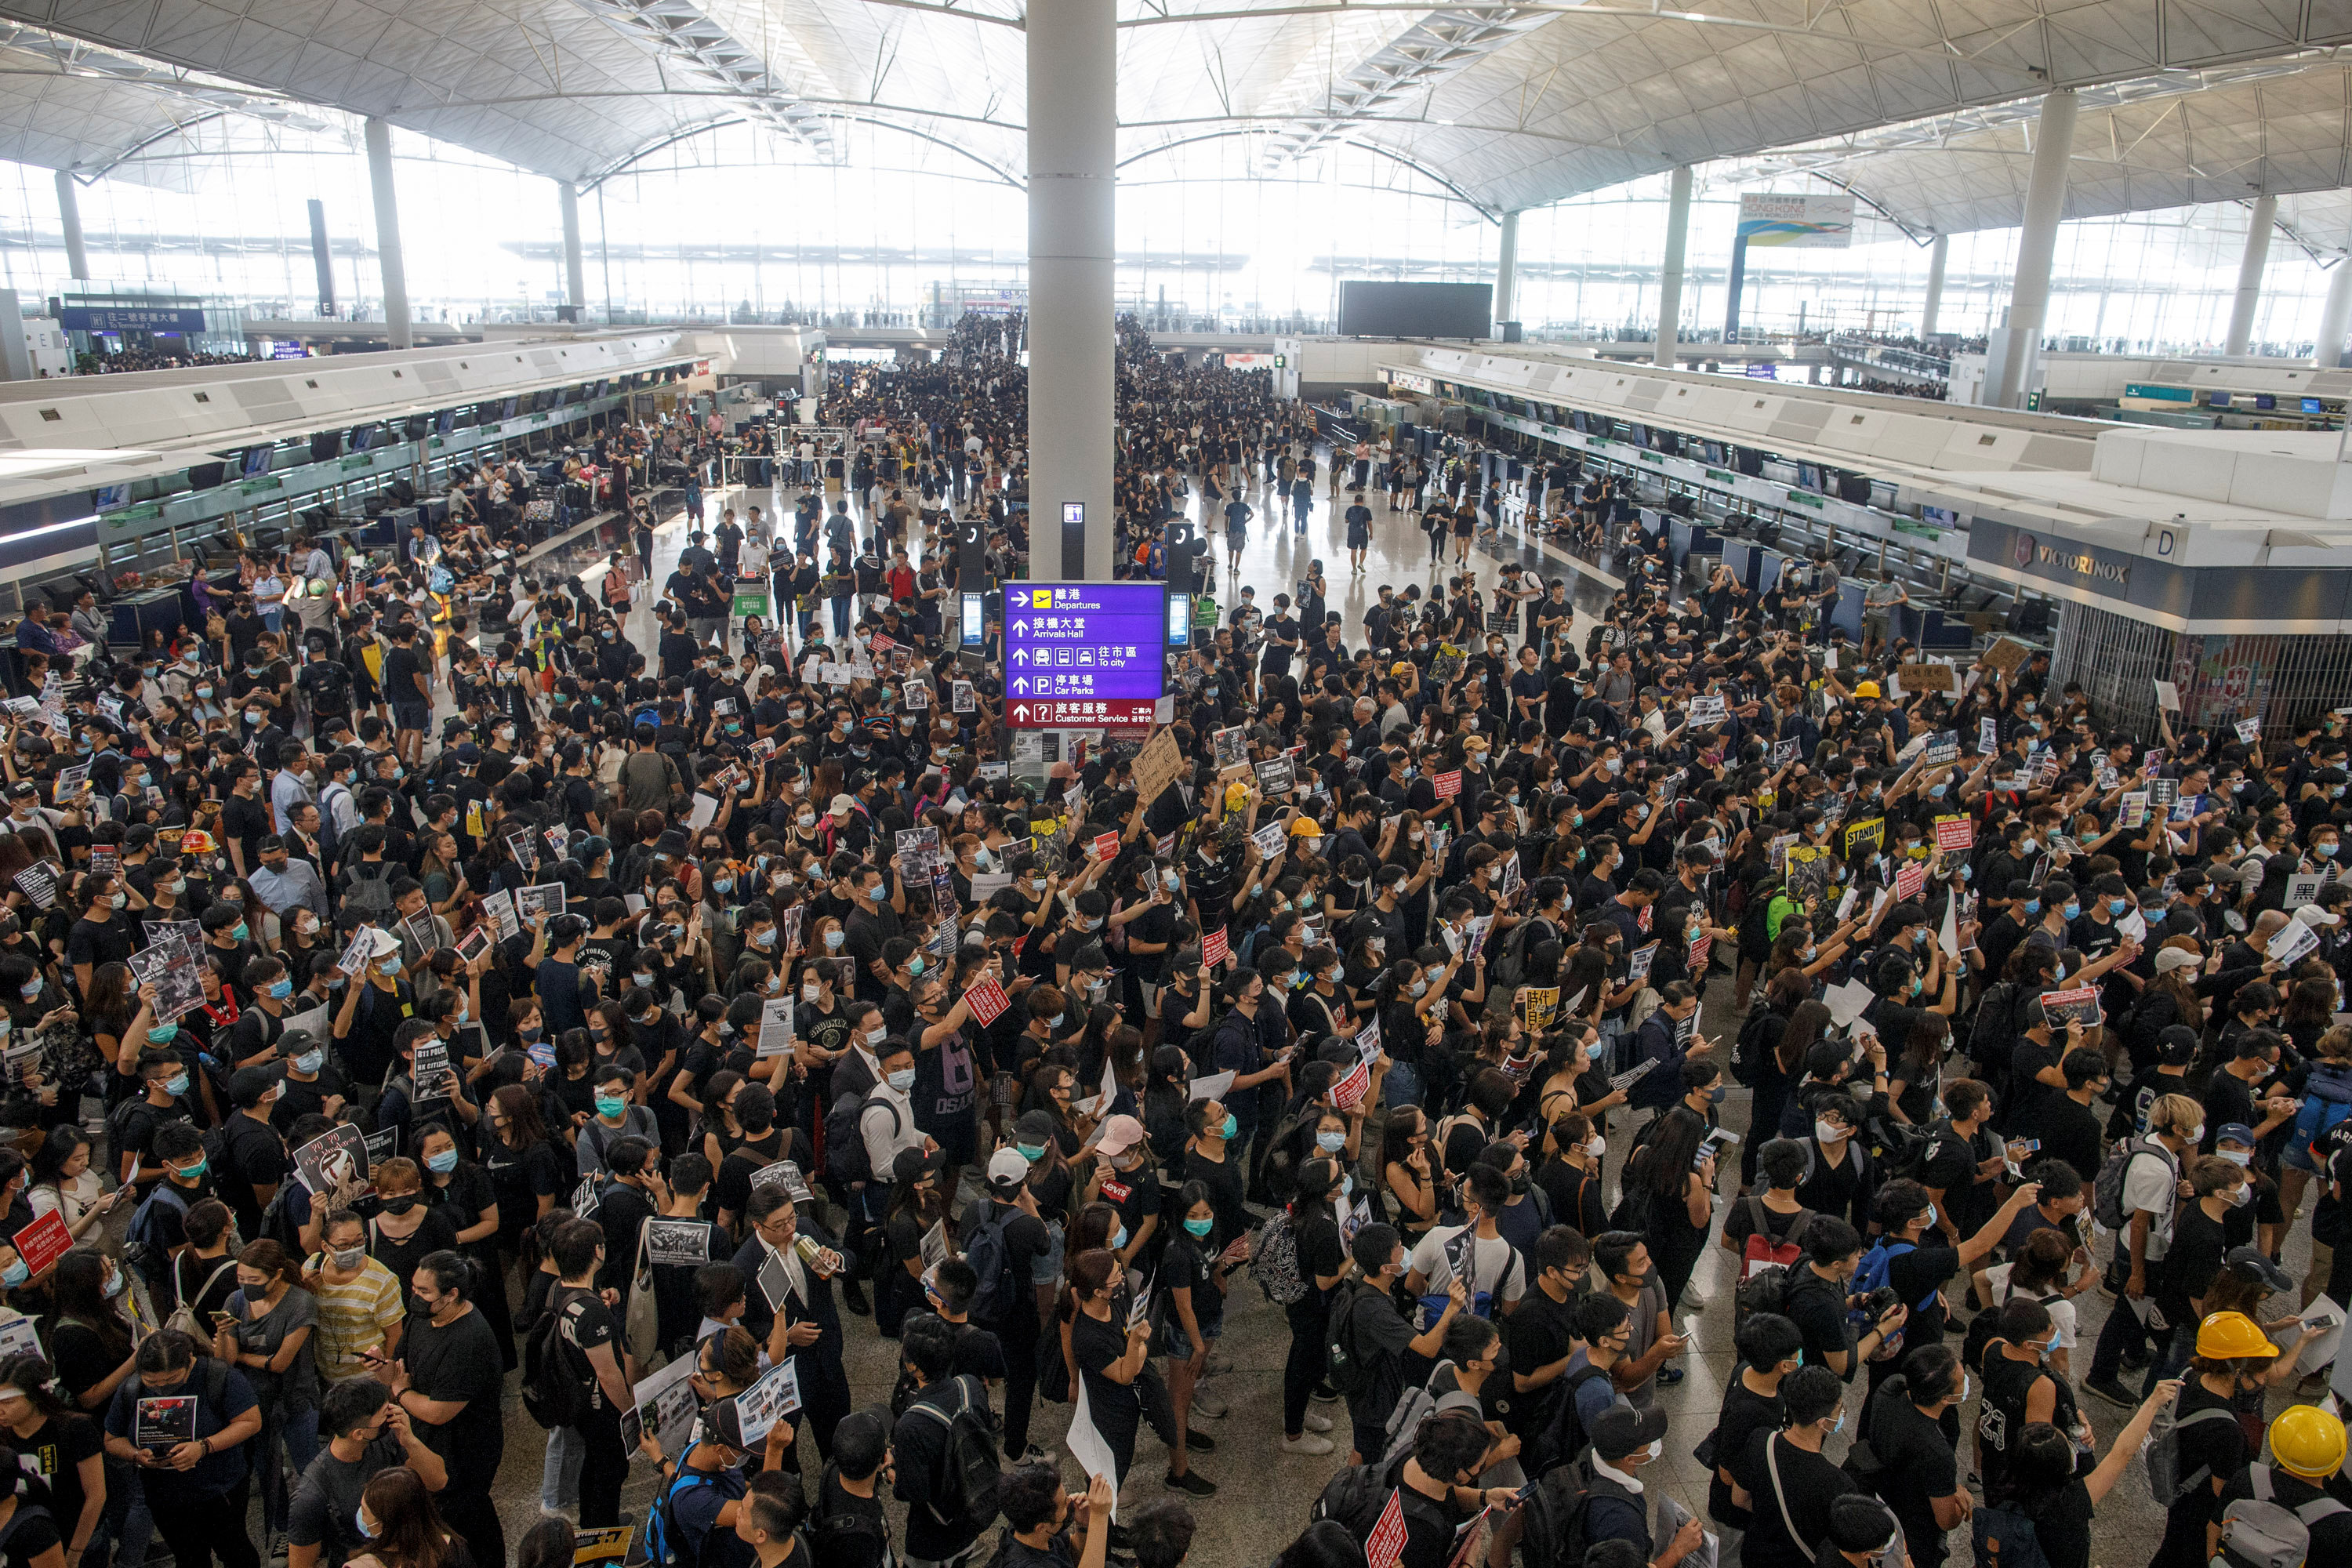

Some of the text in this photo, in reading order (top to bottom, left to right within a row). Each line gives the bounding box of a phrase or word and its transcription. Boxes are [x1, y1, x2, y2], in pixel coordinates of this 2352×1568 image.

[1743, 204, 1806, 213] HONG KONG
[323, 303, 330, 312] E
[40, 333, 47, 347] E
[1727, 331, 1735, 341] C
[1964, 366, 1970, 379] C
[2158, 530, 2174, 555] D
[2039, 546, 2129, 583] VICTORINOX
[1055, 588, 1080, 600] 離港
[1055, 601, 1101, 610] Departures
[1033, 617, 1085, 629] 接機大堂
[1098, 646, 1137, 657] 往市區
[1111, 658, 1125, 668] city
[1055, 675, 1093, 686] 停車場
[1055, 702, 1107, 714] 旅客服務
[1848, 820, 1884, 843] STAND UP
[23, 867, 38, 877] POLICE
[2294, 884, 2315, 900] 黑
[1211, 941, 1222, 950] POLICE
[575, 950, 585, 962] NEW
[601, 950, 612, 961] CITY
[140, 965, 164, 978] THEY SHOT
[155, 969, 167, 978] SHOT
[192, 997, 203, 1005] POLICE
[972, 990, 986, 1010] SELECTIVE
[1527, 991, 1550, 1011] 時代
[967, 994, 988, 1022] ENFORCEMENT
[809, 1018, 848, 1038] BROOKLY
[417, 1049, 429, 1058] 811
[426, 1060, 448, 1069] CITIZENS
[1345, 1083, 1358, 1096] POLICE
[1347, 1086, 1360, 1099] ANGRY
[368, 1135, 384, 1144] KONG
[380, 1138, 392, 1147] SAFE
[1102, 1181, 1127, 1197] Levi's
[1452, 1258, 1463, 1269] THEY
[44, 1447, 52, 1473] 時代革命
[1377, 1529, 1390, 1553] POLICE
[1389, 1510, 1399, 1529] MAKE
[1394, 1525, 1402, 1541] LAW
[1379, 1535, 1392, 1560] ANGRY
[1391, 1517, 1401, 1536] WITH
